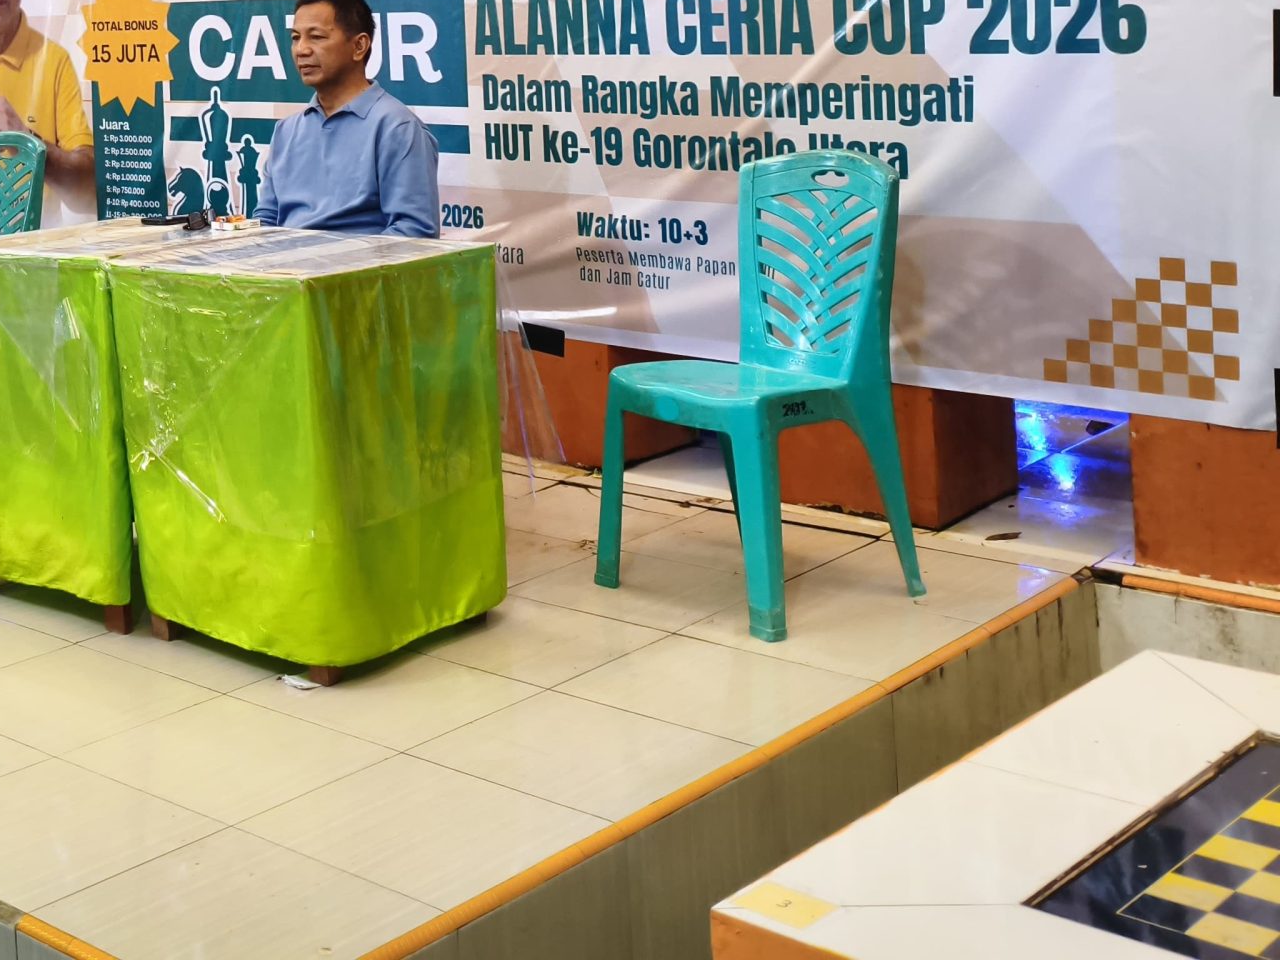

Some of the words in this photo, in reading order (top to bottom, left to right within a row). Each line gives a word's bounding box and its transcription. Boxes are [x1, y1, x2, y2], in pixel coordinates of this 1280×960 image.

[92, 21, 122, 31] TOTAL
[124, 20, 158, 30] BONUS
[92, 44, 111, 63] 15
[116, 43, 160, 62] JUTA
[188, 11, 443, 84] CAR
[482, 74, 572, 114] Dalam
[582, 76, 699, 119] Rangka
[710, 74, 975, 125] Memperingati
[99, 118, 130, 131] Juara
[110, 135, 118, 143] Rp
[119, 135, 152, 143] 3.000.000
[485, 123, 534, 163] HUT
[543, 125, 623, 167] ke-19
[111, 148, 119, 156] Rp
[120, 148, 152, 156] 2.500.000
[111, 161, 120, 169] Rp
[121, 161, 152, 169] 2.000.000
[112, 174, 120, 182] Rp
[121, 174, 151, 182] 1.000.000
[113, 186, 121, 195] Rp
[121, 186, 145, 195] 750.000
[120, 199, 129, 208] Rp
[129, 200, 160, 208] 400.000
[441, 204, 484, 229] 2026
[576, 211, 650, 241] Waktu:
[658, 217, 708, 246] 10+3
[496, 242, 524, 265] tara
[576, 247, 624, 266] Peserta
[629, 251, 691, 272] Membawa
[697, 256, 736, 277] Papan
[580, 265, 601, 283] dan
[606, 268, 631, 286] Jam
[637, 271, 670, 290] Catur
